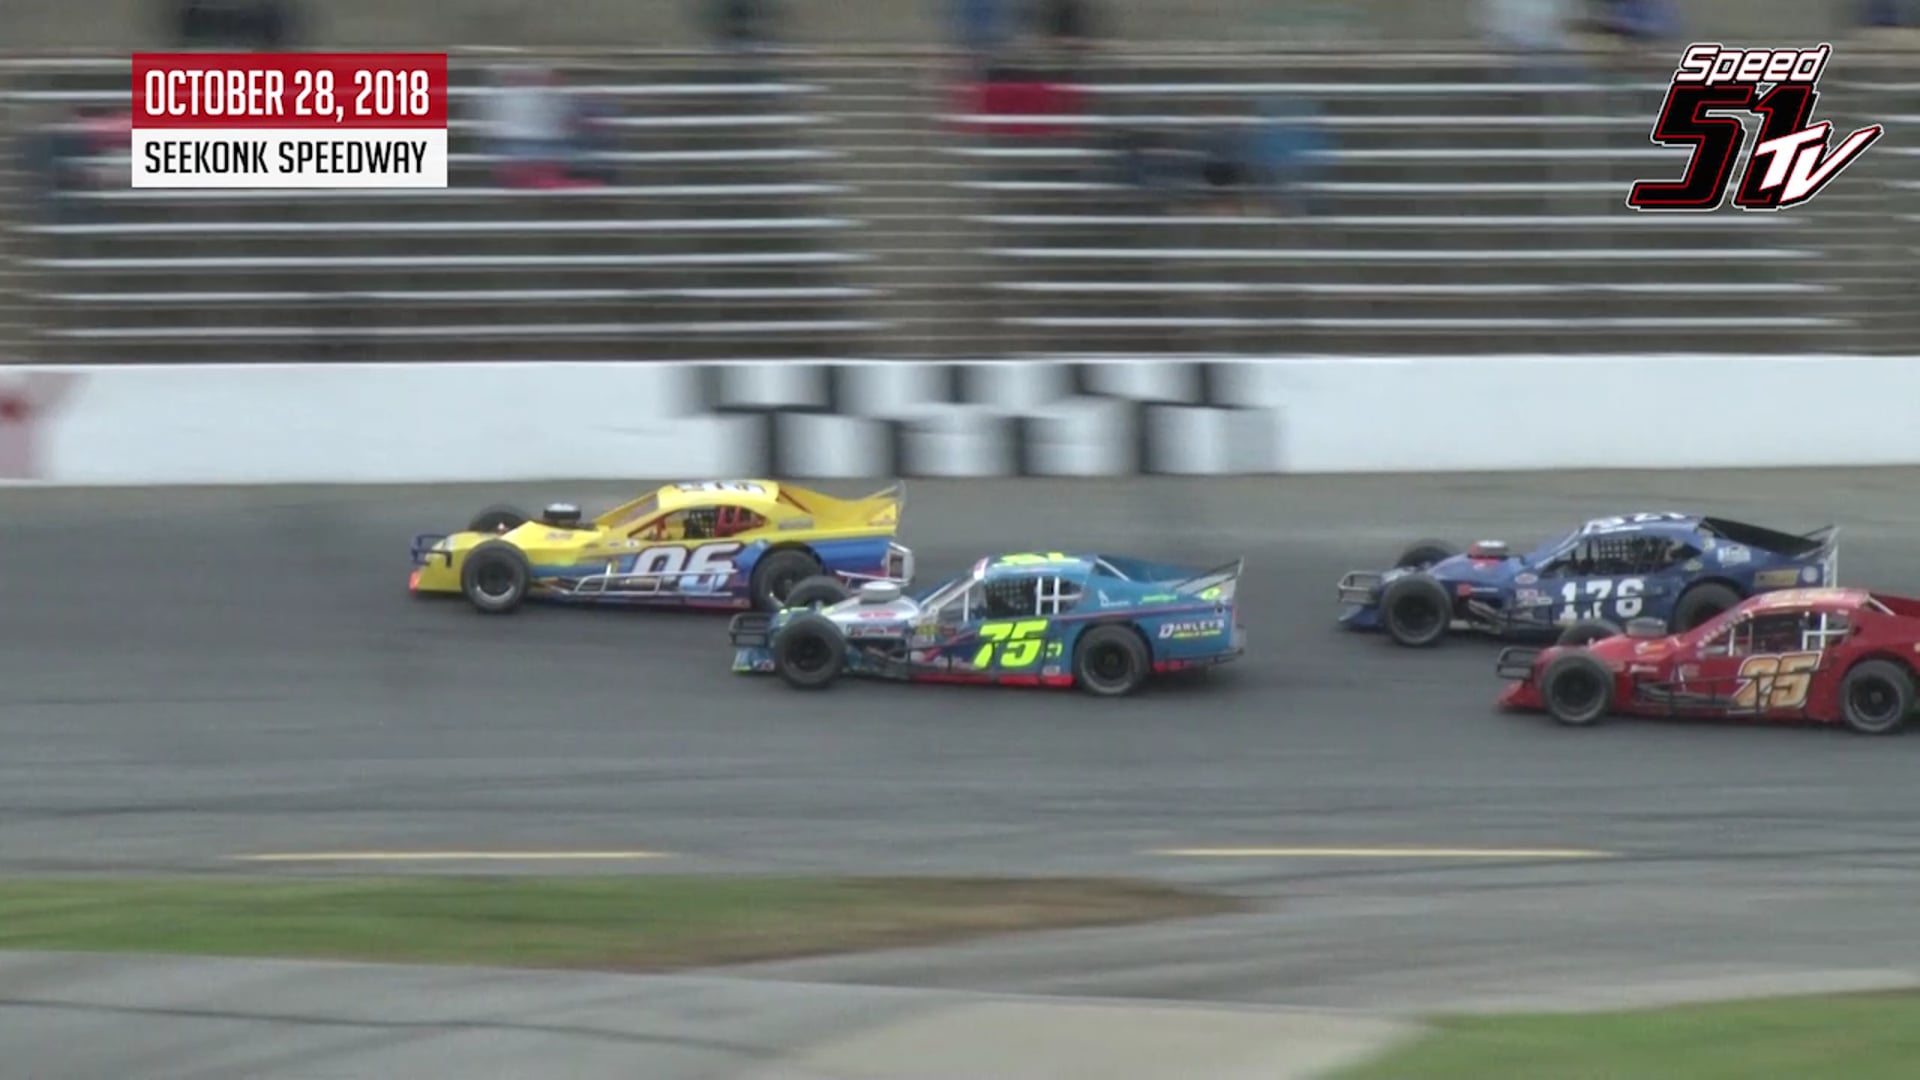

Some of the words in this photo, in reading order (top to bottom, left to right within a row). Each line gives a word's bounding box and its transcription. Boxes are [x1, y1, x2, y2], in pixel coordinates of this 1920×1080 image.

[1559, 577, 1645, 615] 176
[974, 619, 1048, 667] 75
[1729, 650, 1822, 711] 25
